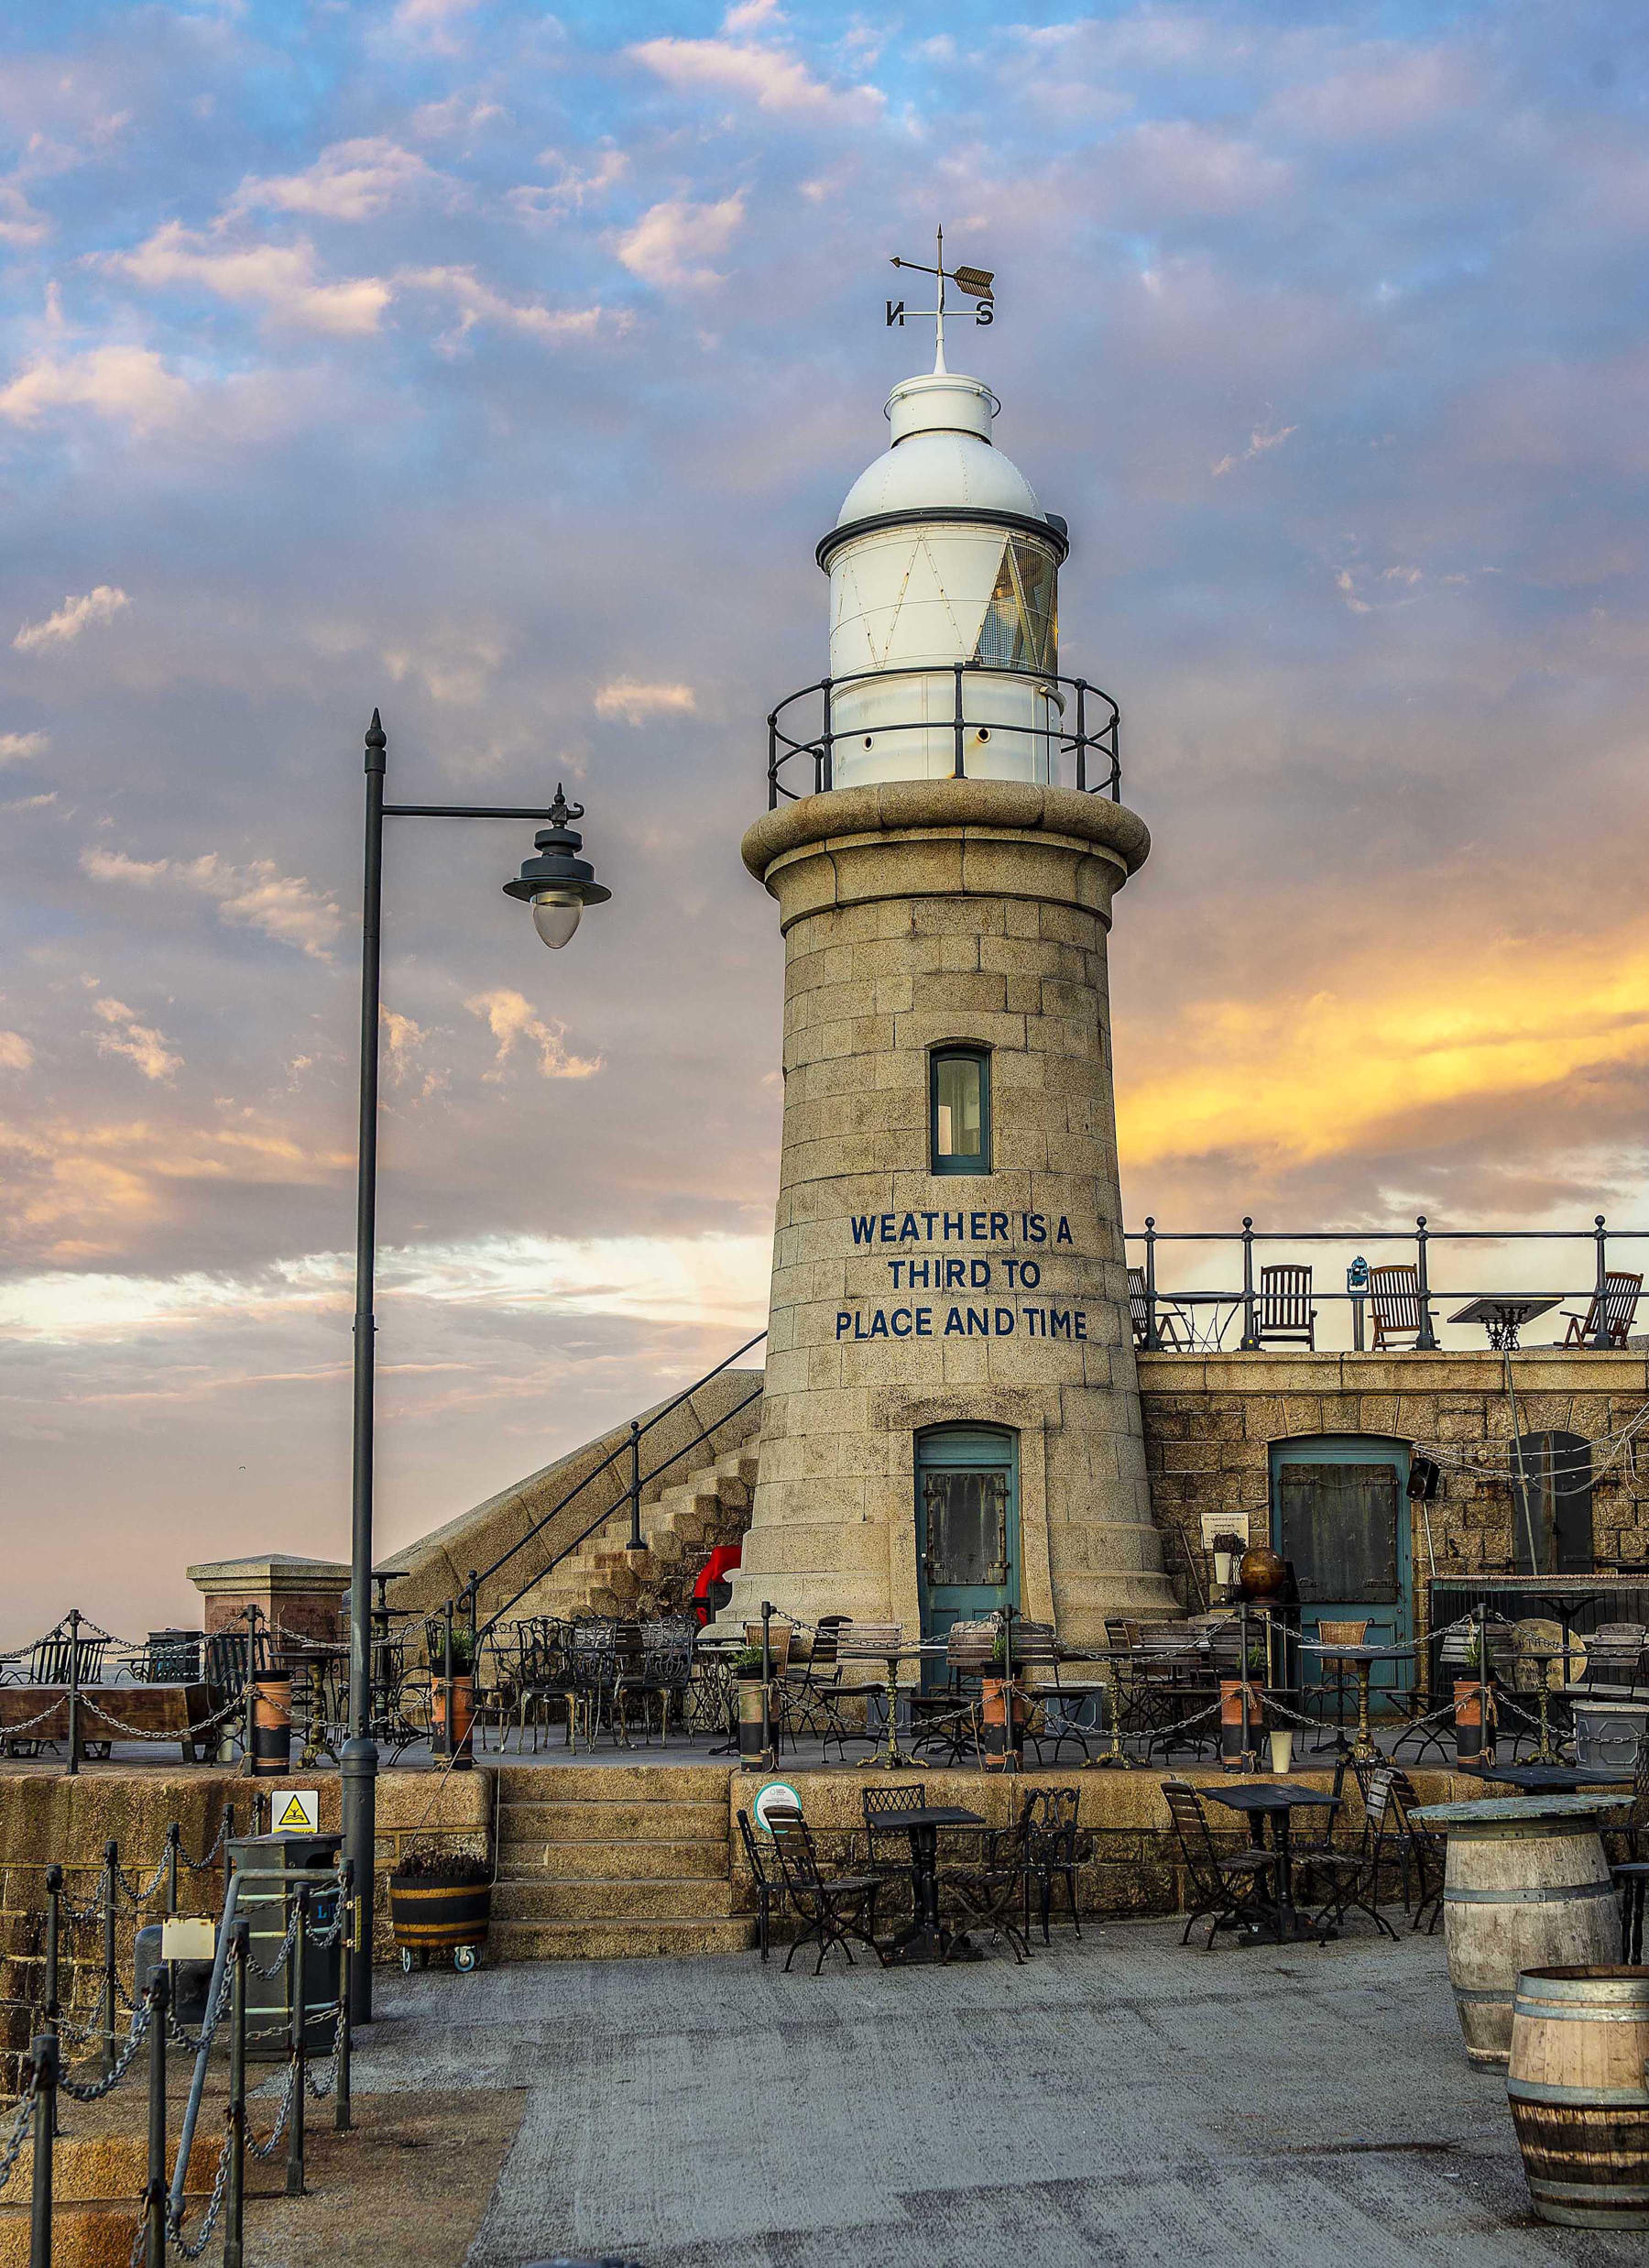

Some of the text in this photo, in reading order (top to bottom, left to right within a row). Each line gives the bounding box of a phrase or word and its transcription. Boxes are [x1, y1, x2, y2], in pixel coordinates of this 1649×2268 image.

[851, 1211, 1074, 1244] WEATHER IS A
[888, 1259, 1041, 1289] THIRD TO
[835, 1307, 1087, 1341] PLACE AND TIME
